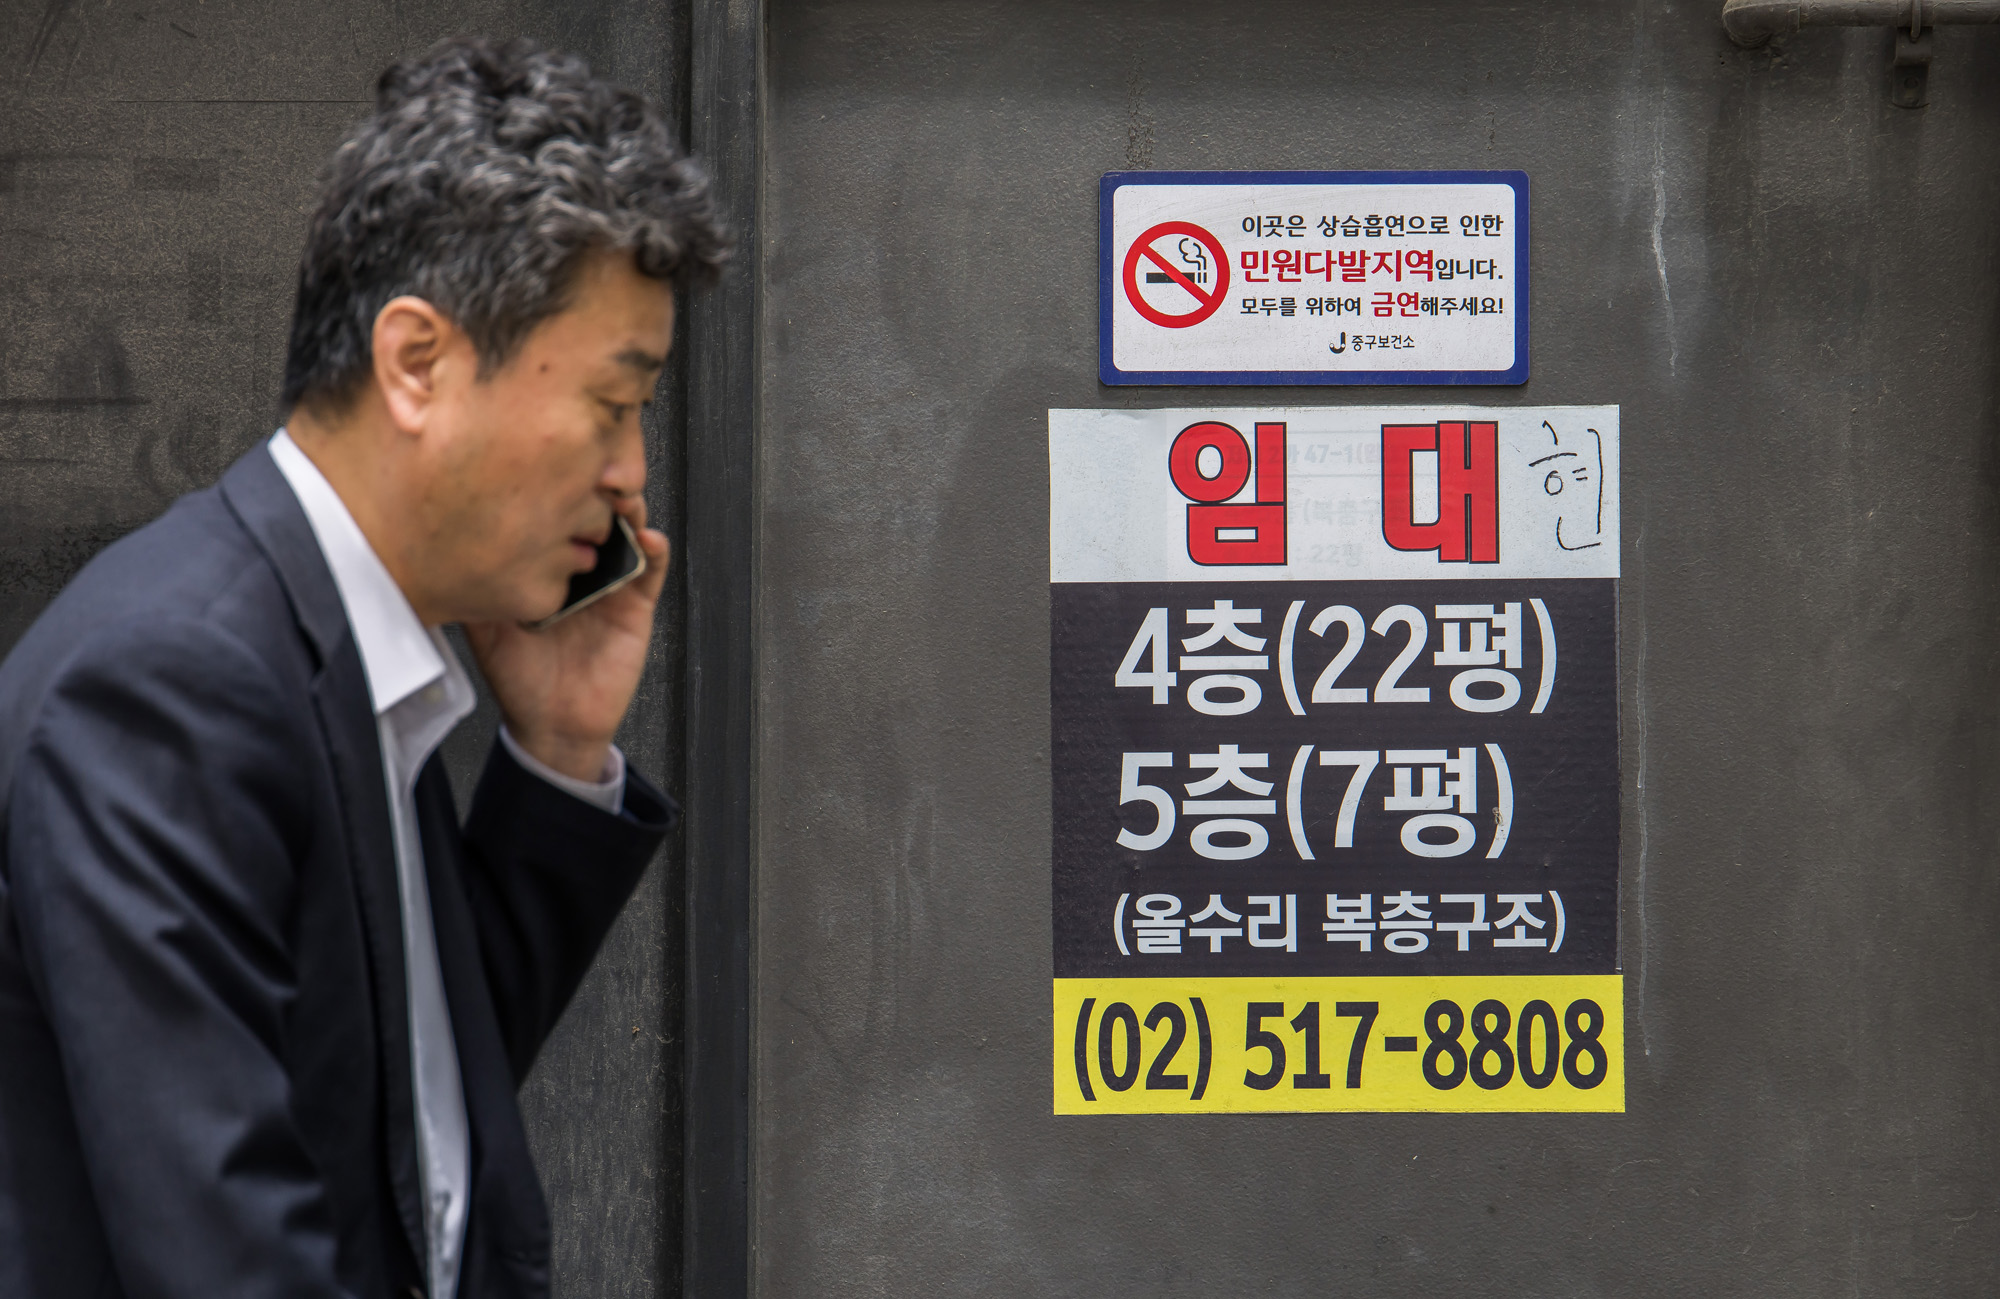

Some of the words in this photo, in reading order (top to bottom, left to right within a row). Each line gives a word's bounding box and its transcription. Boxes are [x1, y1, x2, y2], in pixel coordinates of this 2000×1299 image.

[1242, 215, 1306, 237] 이곳은
[1317, 215, 1450, 237] 상습흡연으로
[1460, 215, 1504, 236] 인한
[1241, 250, 1503, 282] 민원다발지역입니다.
[1241, 298, 1297, 316] 모두를
[1306, 297, 1360, 316] 위하여
[1371, 292, 1503, 317] 금연해주세요!
[1352, 335, 1415, 351] 중구보건소
[1116, 599, 1556, 715] 4층(22평)
[1116, 744, 1513, 860] 5층(7평)
[1114, 894, 1296, 955] (올수리
[1323, 891, 1564, 953] 복층구조)
[1075, 997, 1212, 1101] (02)
[1244, 999, 1607, 1090] 517-8808
